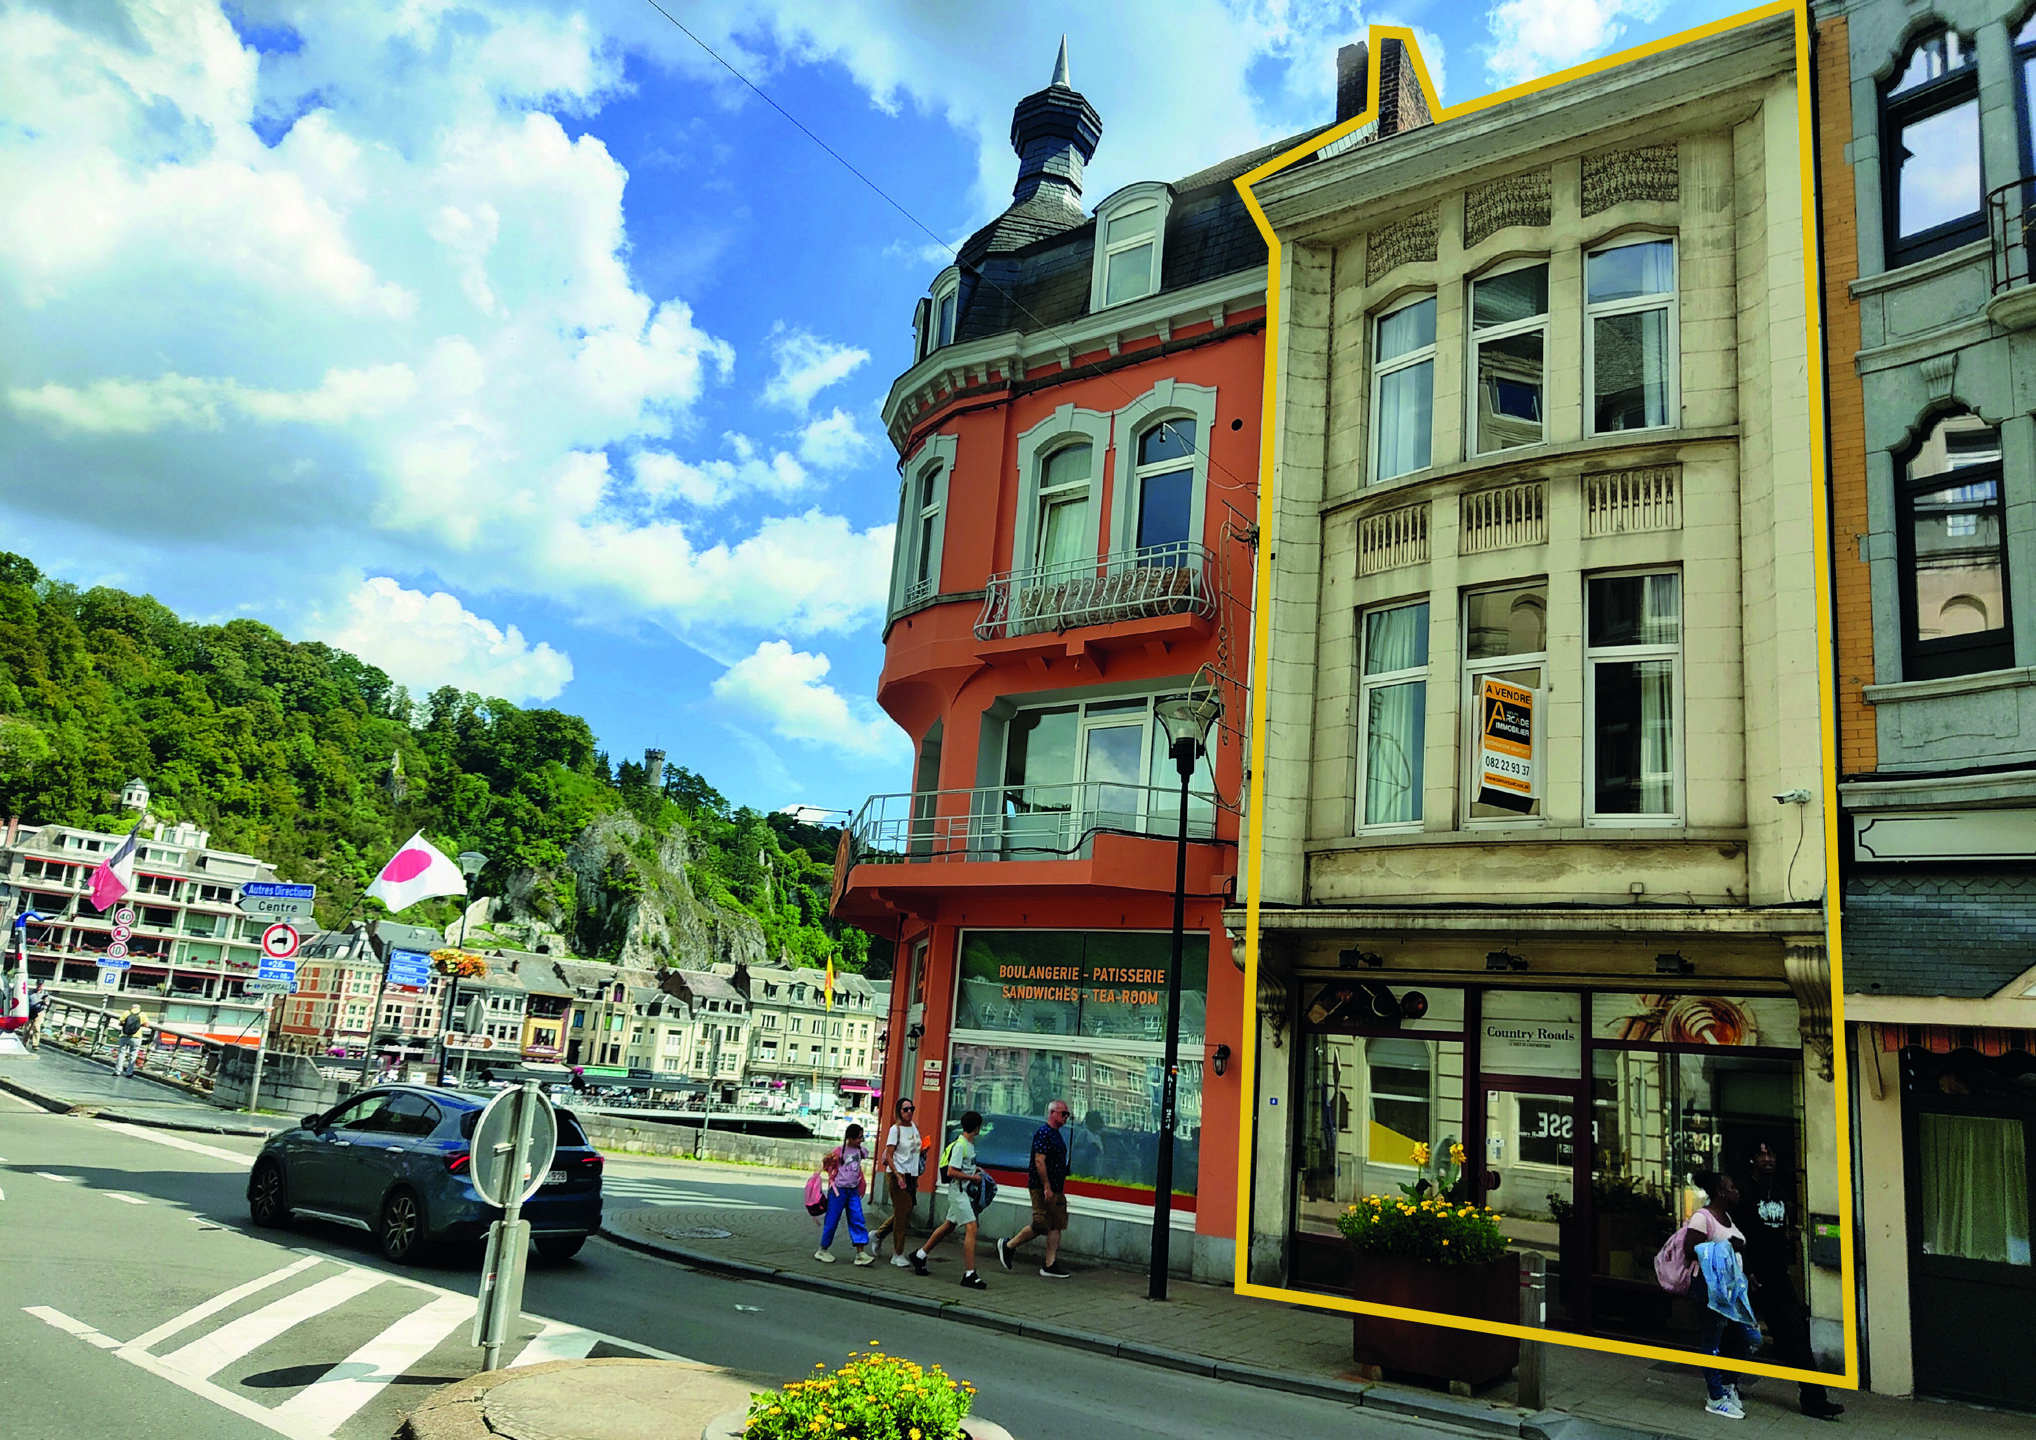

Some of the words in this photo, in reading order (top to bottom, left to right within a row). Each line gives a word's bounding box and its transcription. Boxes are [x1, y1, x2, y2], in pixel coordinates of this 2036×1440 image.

[1486, 685, 1492, 693] A
[1495, 686, 1531, 704] VENDRE
[1495, 721, 1530, 737] IMMOBILIER
[1485, 756, 1499, 769] 082
[1501, 760, 1510, 771] 22
[1511, 763, 1520, 774] 93
[1521, 765, 1530, 776] 37
[248, 885, 274, 895] Autres
[275, 885, 312, 897] Directions
[258, 901, 298, 912] Centre
[999, 965, 1080, 981] BOULANGERIE
[1092, 967, 1166, 983] PATISSERIE
[1002, 986, 1079, 1002] SANDWICHES
[1092, 988, 1159, 1005] TEA-ROOM
[1487, 1026, 1534, 1039] Country
[1538, 1028, 1575, 1041] Roads
